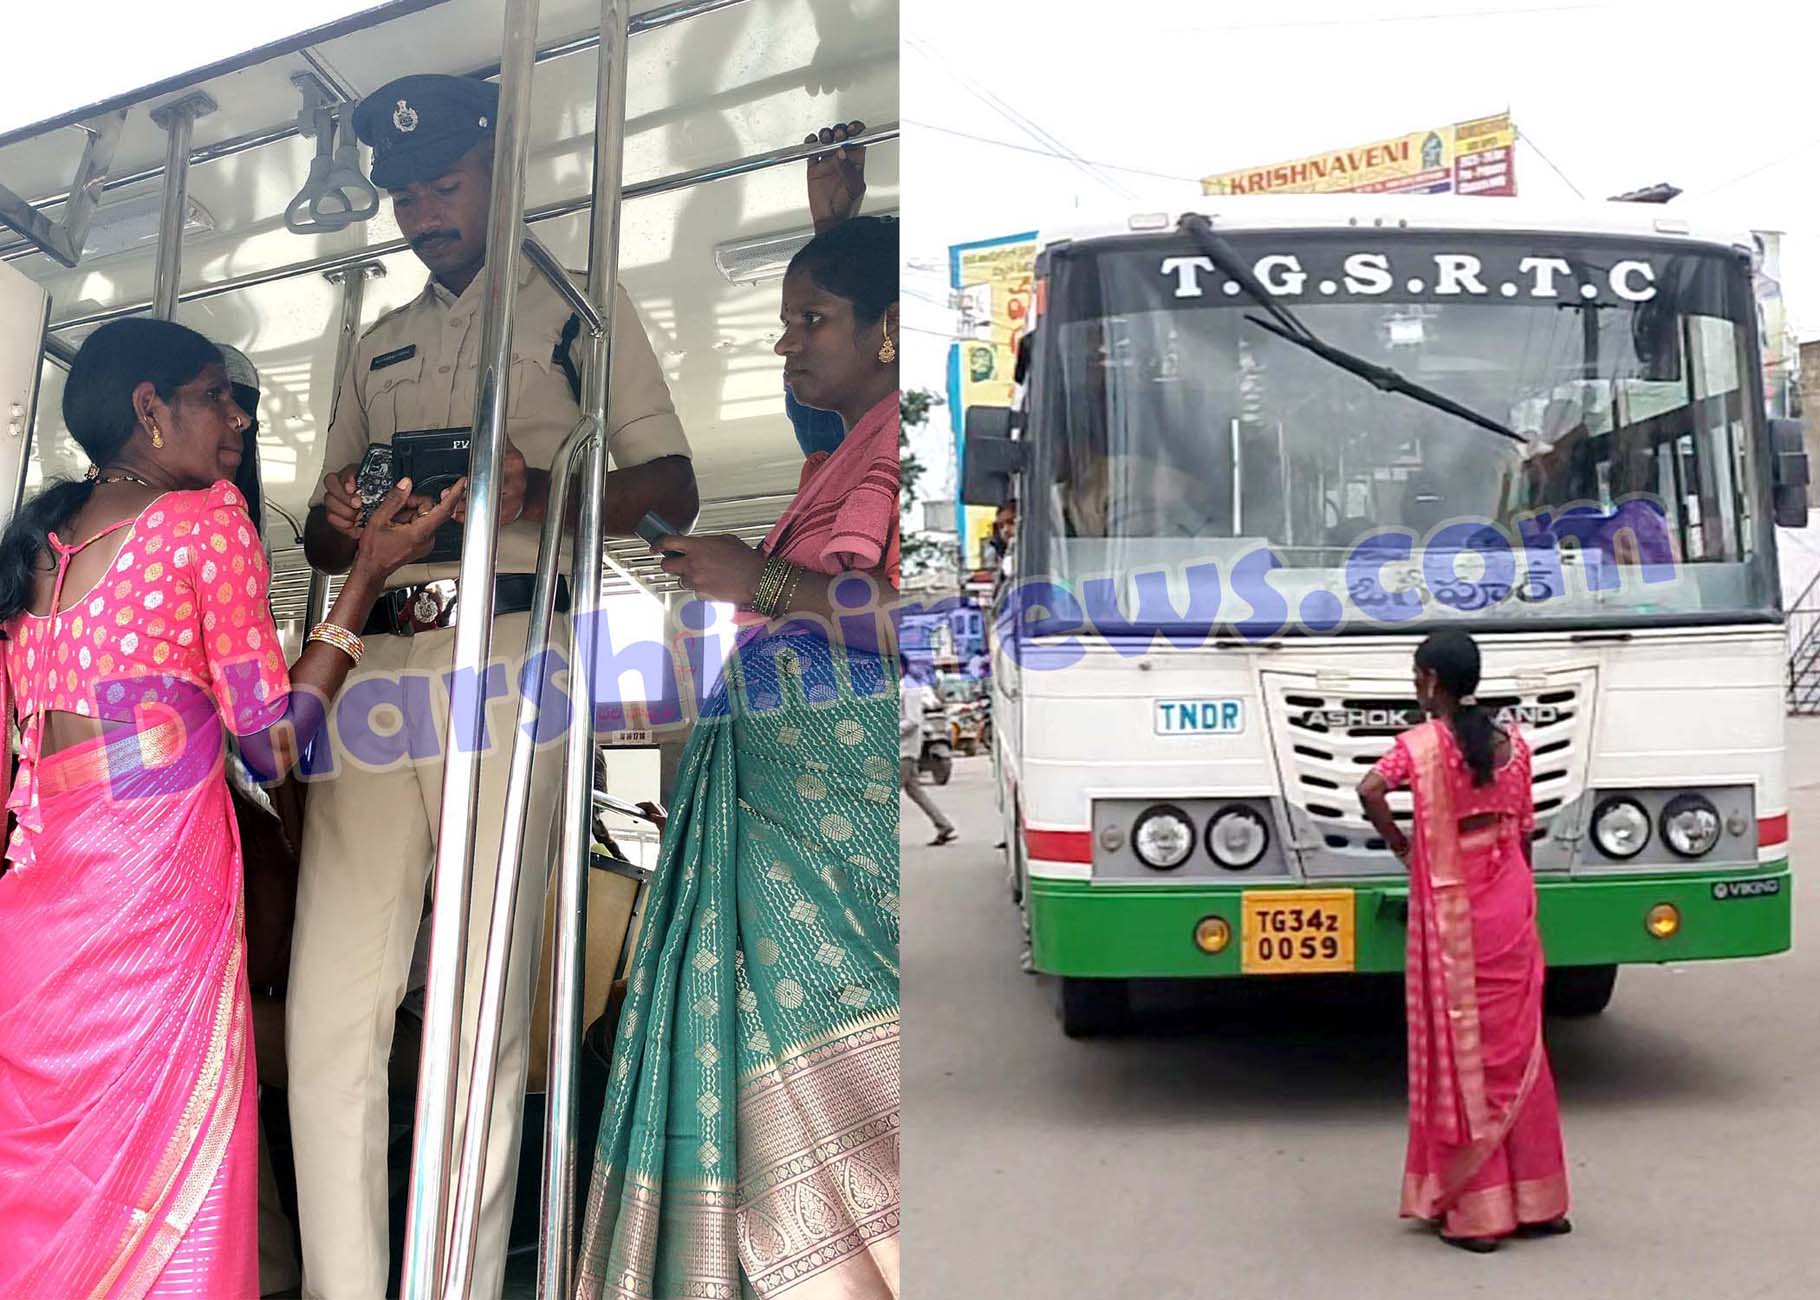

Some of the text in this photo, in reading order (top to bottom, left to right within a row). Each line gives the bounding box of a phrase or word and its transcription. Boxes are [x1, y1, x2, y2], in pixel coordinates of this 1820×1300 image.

[1230, 141, 1409, 194] KRISHNAVENI
[1158, 702, 1238, 730] TNDR
[1306, 709, 1408, 727] ASHOK
[1259, 936, 1339, 961] 0059
